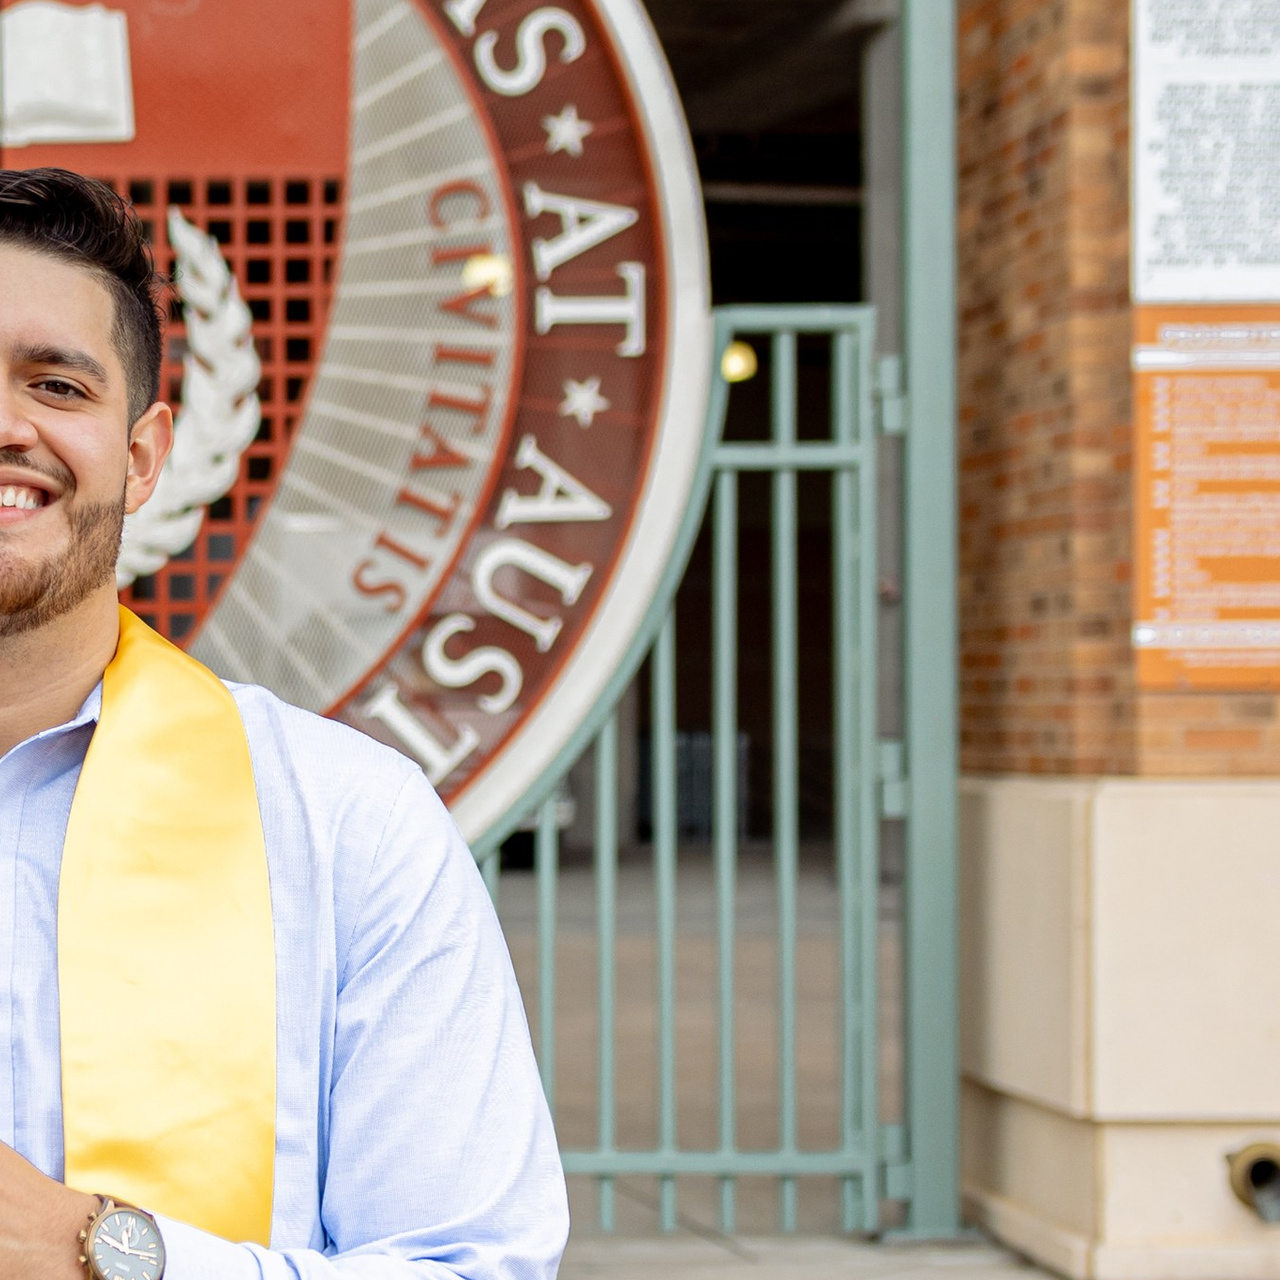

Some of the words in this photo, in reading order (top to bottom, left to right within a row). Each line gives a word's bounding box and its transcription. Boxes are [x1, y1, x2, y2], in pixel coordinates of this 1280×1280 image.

[352, 177, 500, 614] CIVITATIS
[524, 181, 647, 358] AT
[365, 435, 613, 788] AUST
